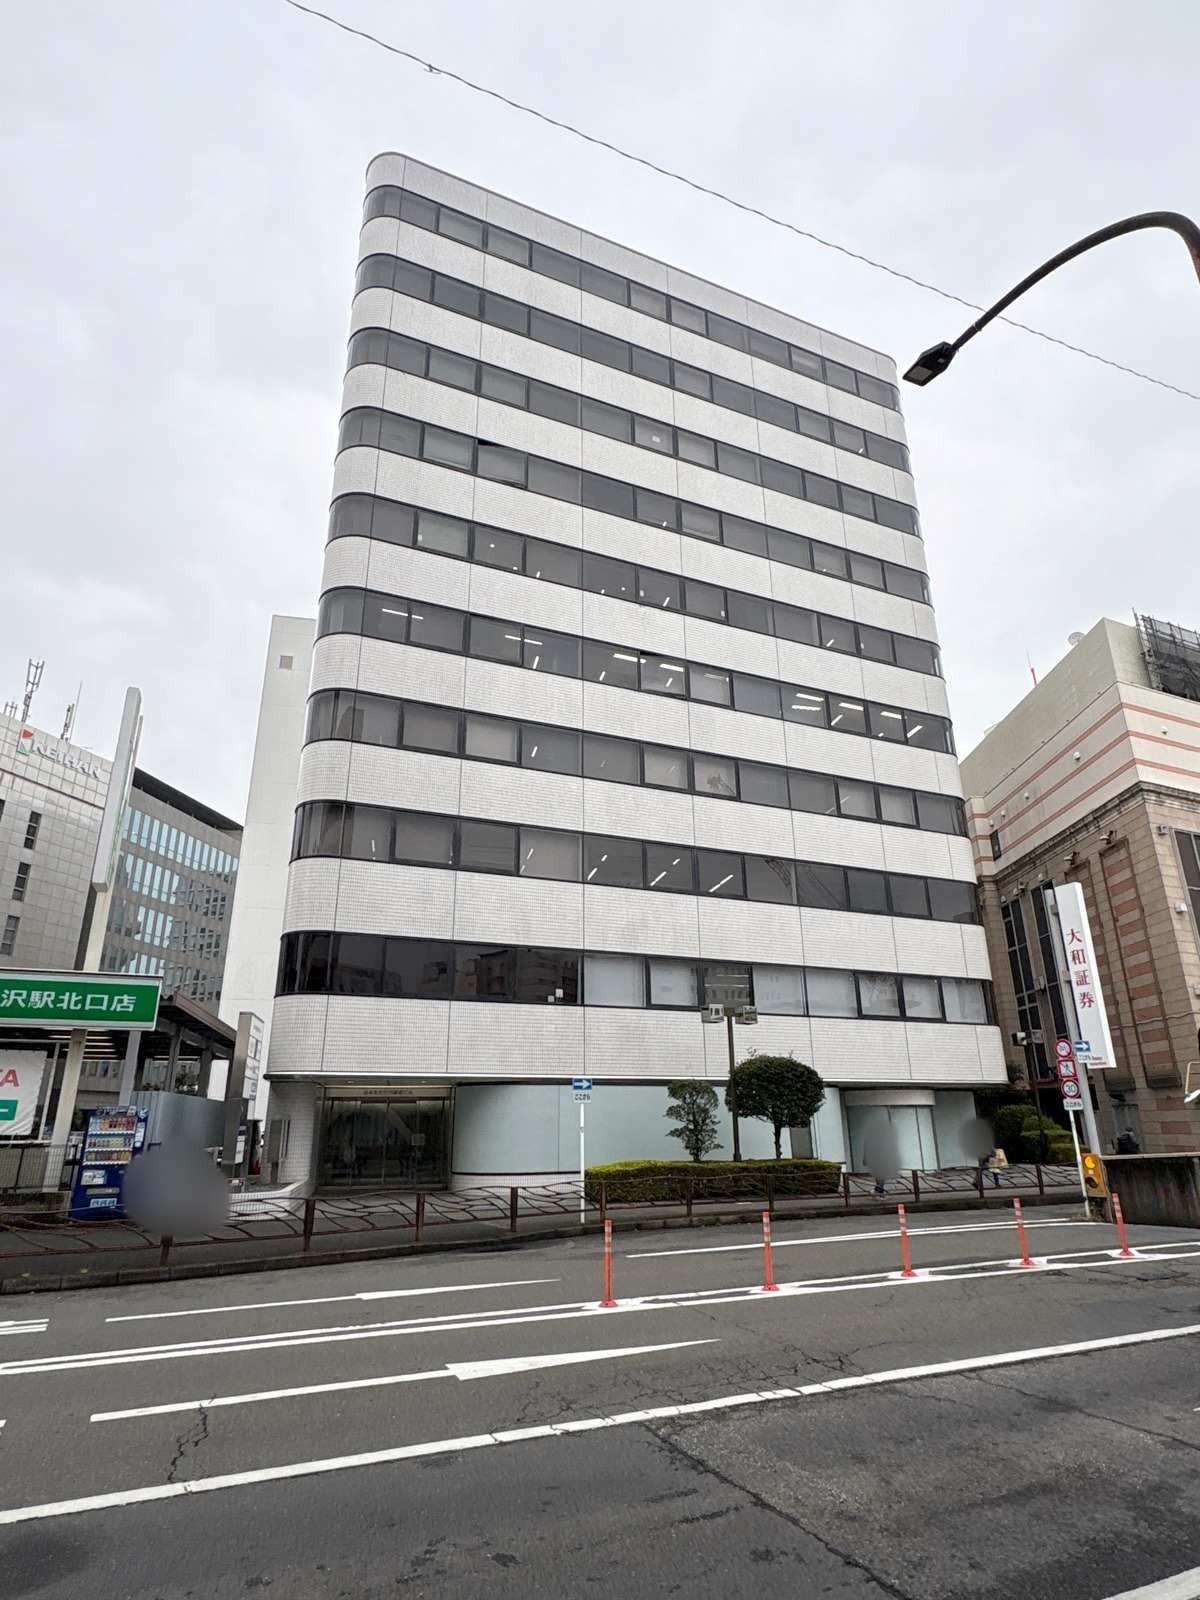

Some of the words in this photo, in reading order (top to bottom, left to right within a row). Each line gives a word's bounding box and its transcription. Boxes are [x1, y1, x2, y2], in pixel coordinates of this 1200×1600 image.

[1066, 928, 1095, 1009] 大和証券
[0, 989, 137, 1012] 沢駅北口店
[1065, 1084, 1077, 1094] 30
